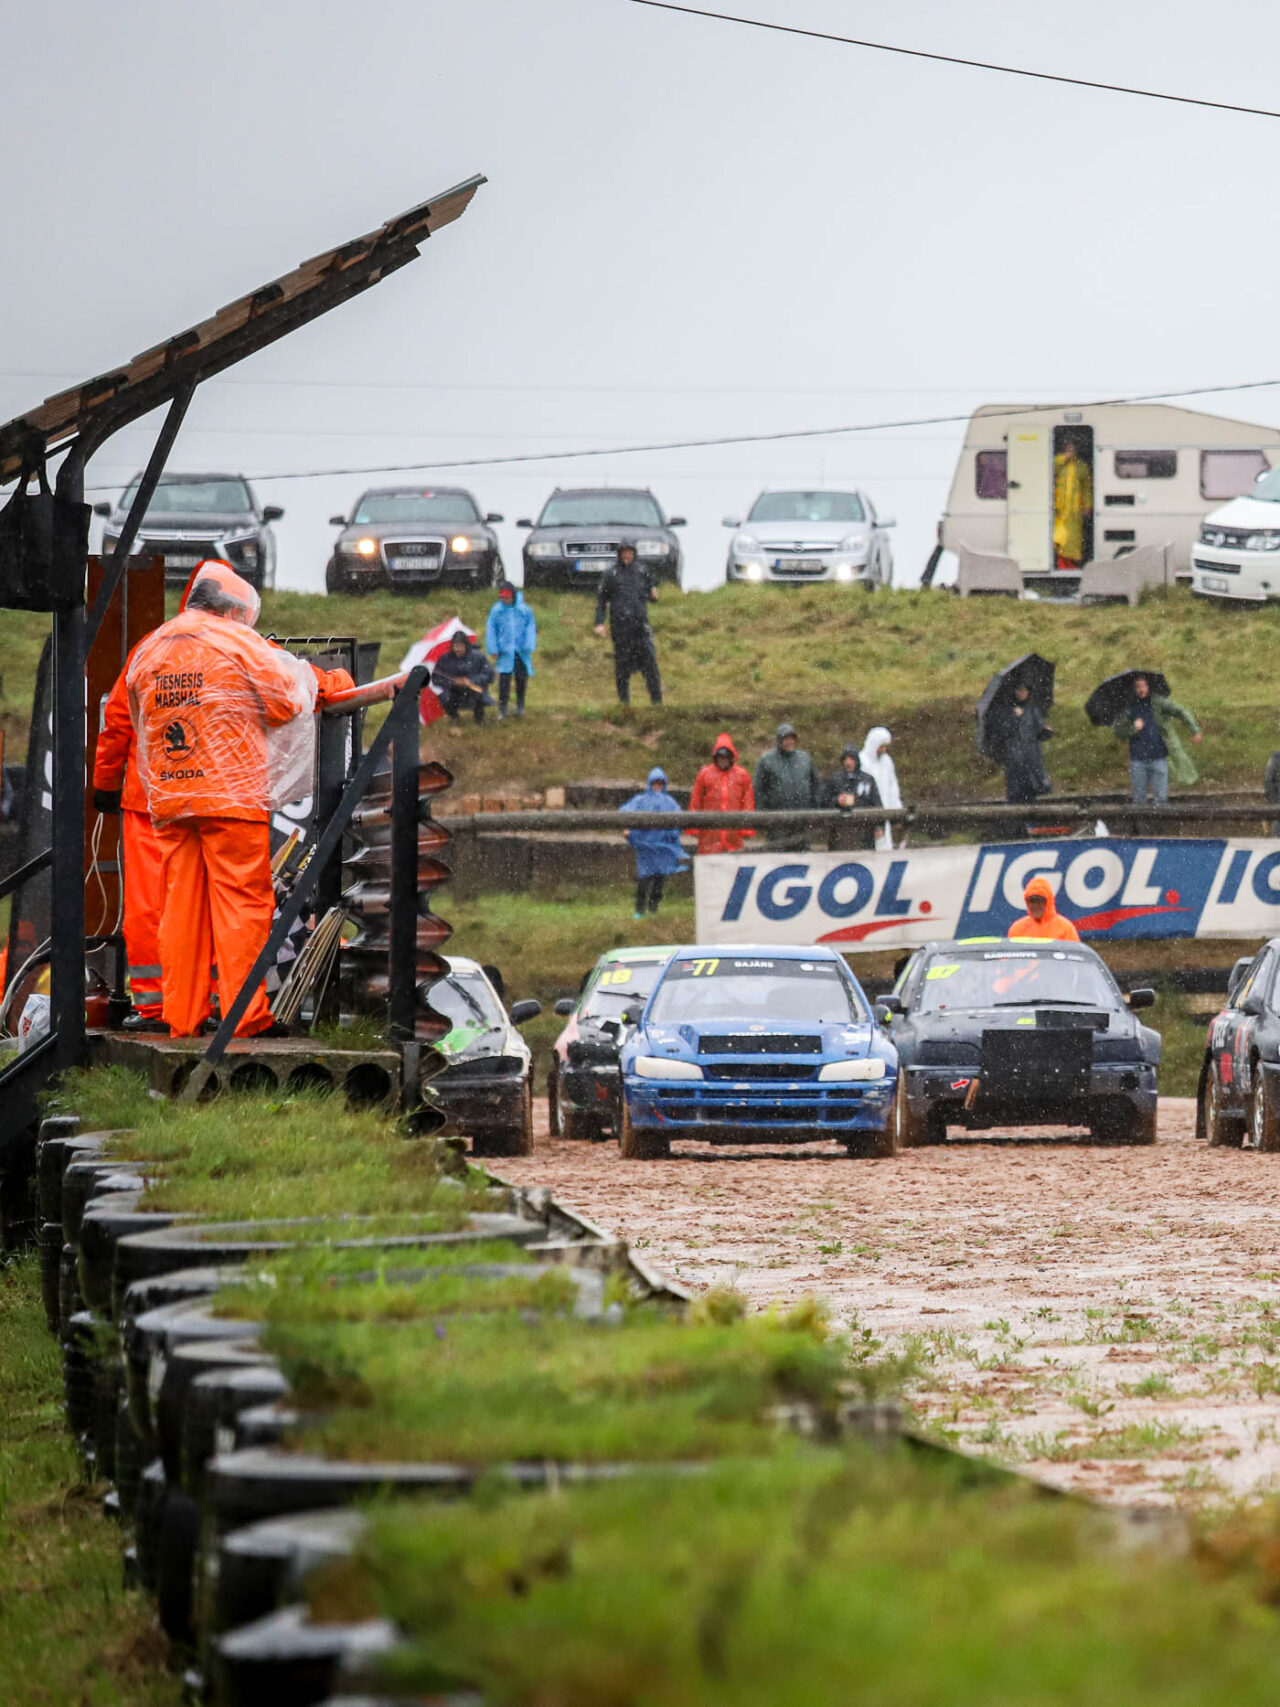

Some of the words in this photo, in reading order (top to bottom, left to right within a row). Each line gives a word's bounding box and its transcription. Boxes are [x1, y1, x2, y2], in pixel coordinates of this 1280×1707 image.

[154, 672, 204, 691] TIESNESIS
[154, 690, 202, 708] MARSHAL
[160, 768, 205, 781] ŠKODA
[692, 958, 720, 977] 77
